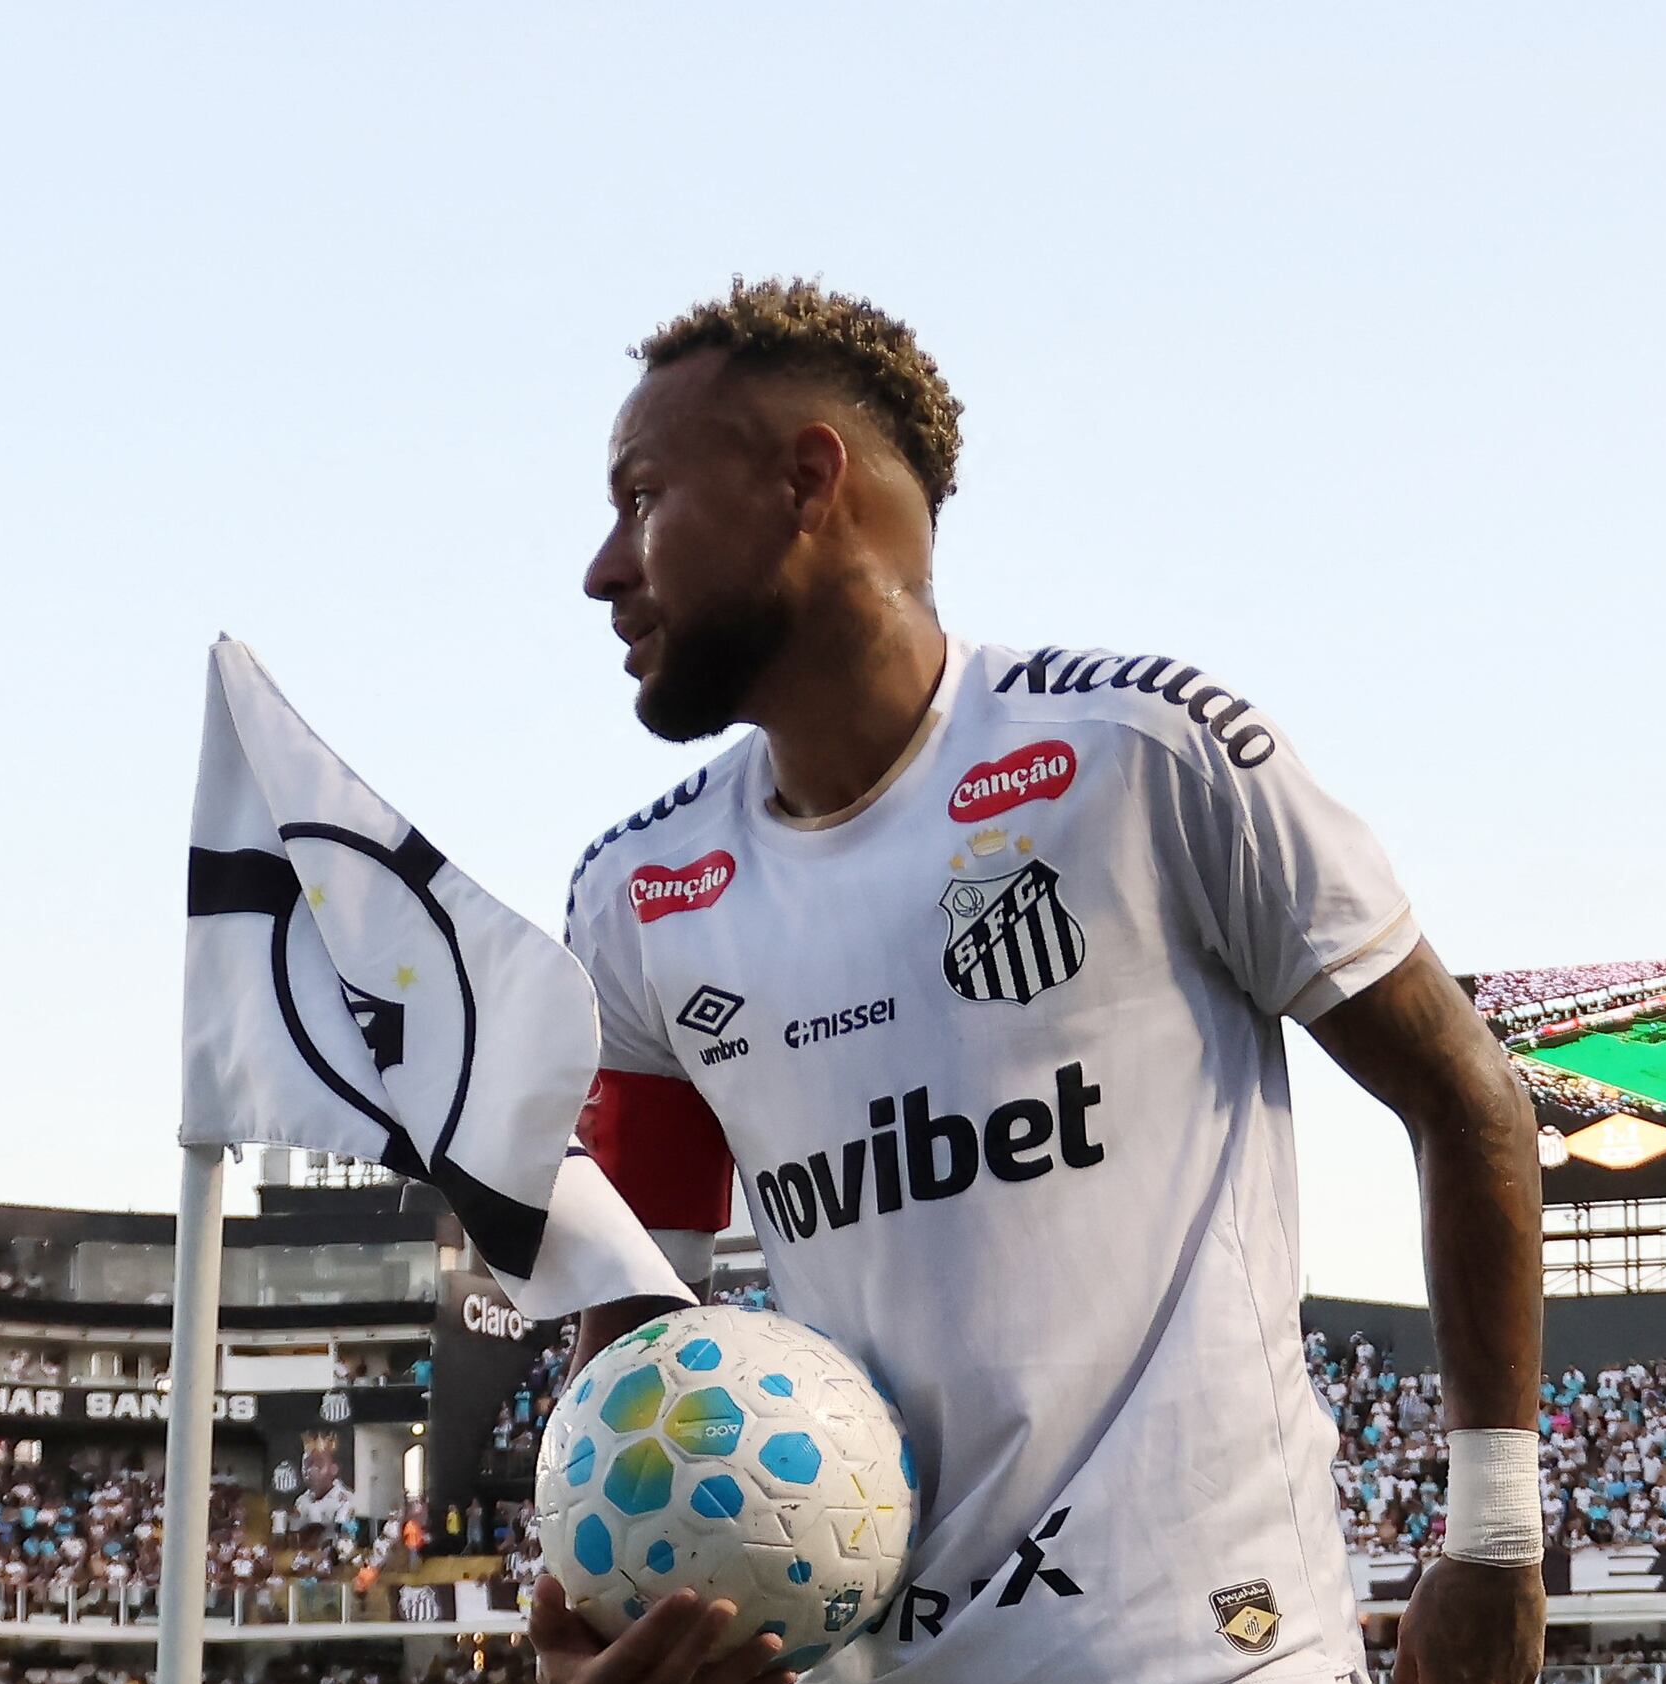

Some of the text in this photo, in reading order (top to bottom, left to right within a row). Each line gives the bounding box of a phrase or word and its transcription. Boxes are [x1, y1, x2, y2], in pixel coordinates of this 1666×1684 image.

[953, 755, 1069, 808] Canção
[630, 866, 728, 907] Canção
[811, 997, 895, 1043] nissei
[699, 1037, 750, 1066] umbro
[756, 1061, 1105, 1243] novibet
[463, 1293, 524, 1340] Claro
[86, 1391, 257, 1421] SANOS
